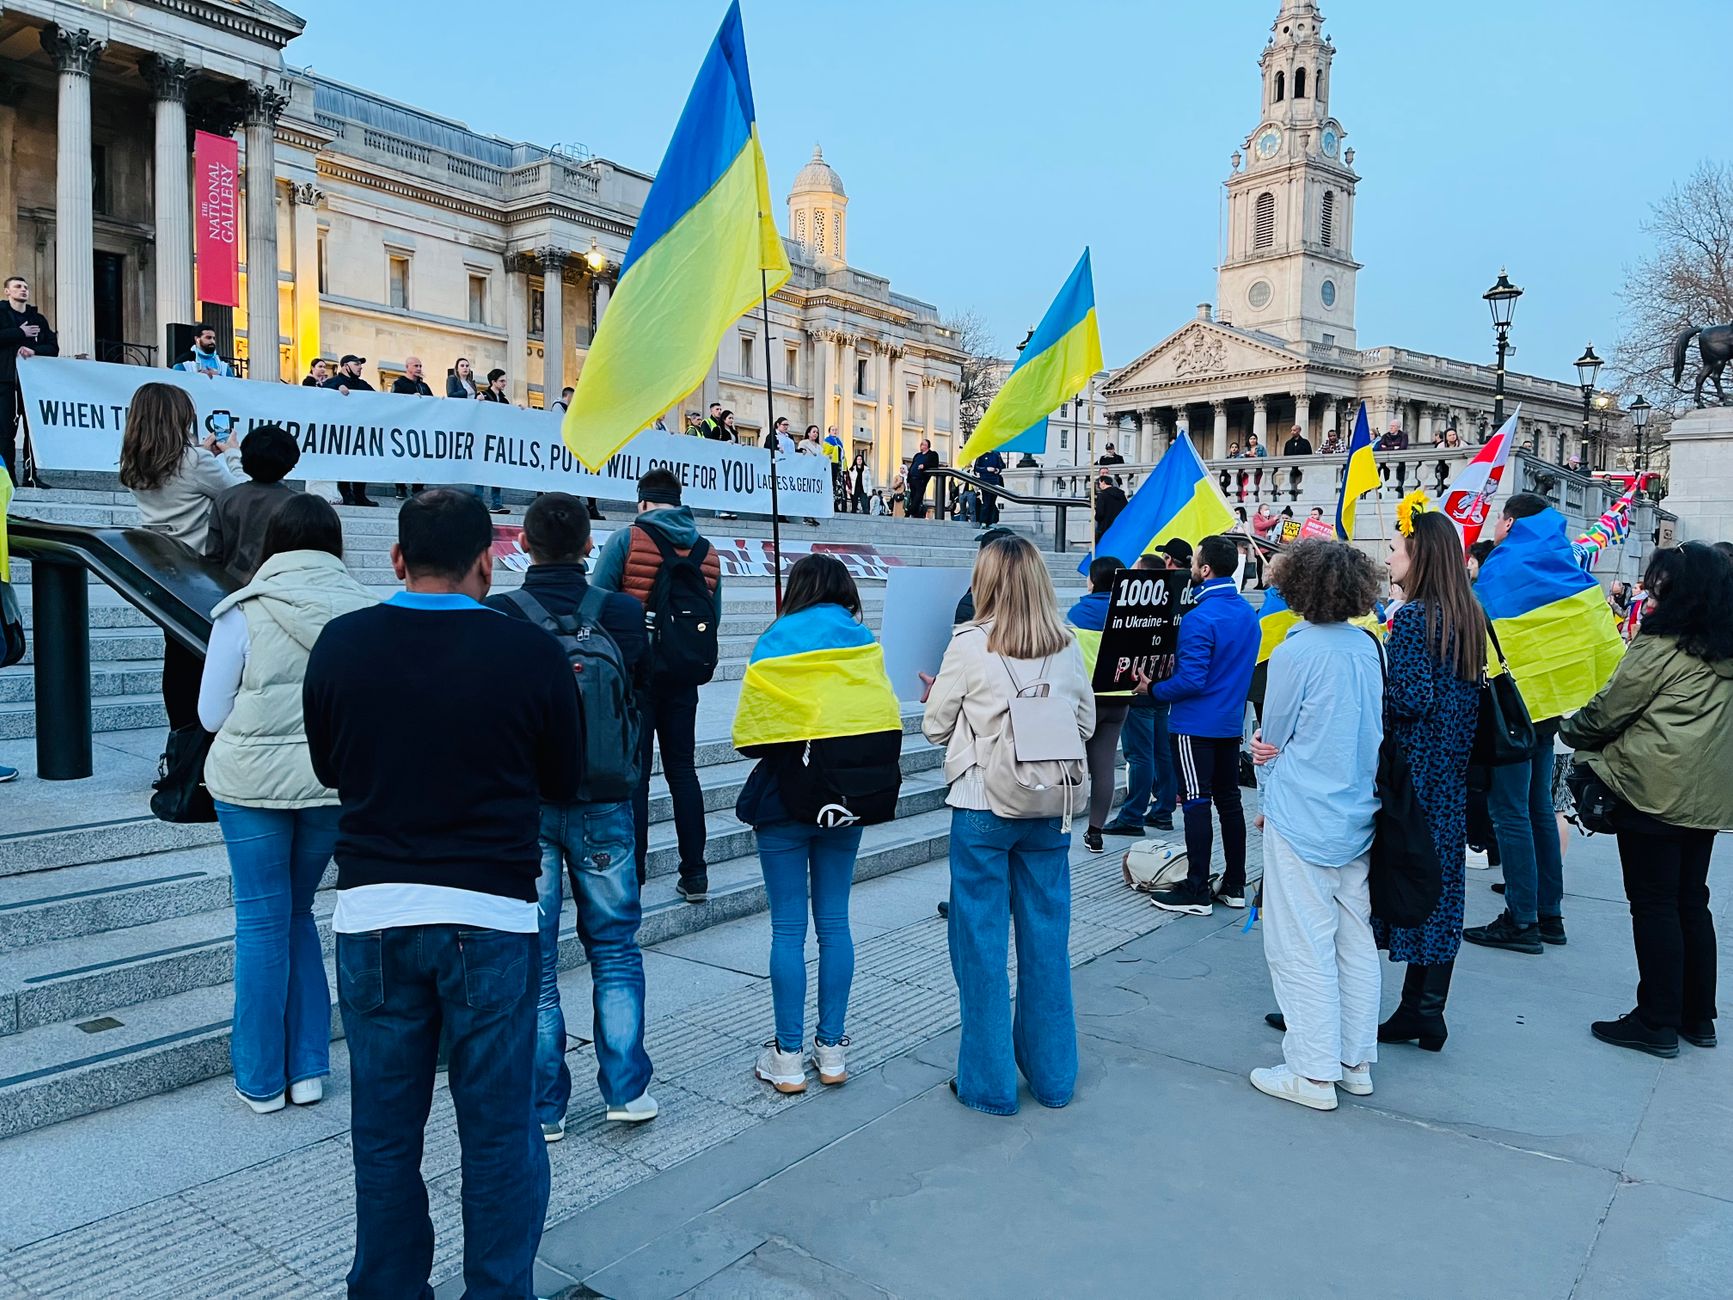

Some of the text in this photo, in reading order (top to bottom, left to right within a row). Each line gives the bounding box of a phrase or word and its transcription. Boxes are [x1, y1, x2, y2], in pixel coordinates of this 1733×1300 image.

[209, 162, 220, 240] NATIONAL
[221, 164, 234, 243] GALLERY
[39, 400, 105, 429] WHEN
[247, 418, 384, 457] RAINIAN
[390, 428, 474, 460] SOLDIER
[484, 434, 544, 472] FALLS,
[693, 464, 717, 490] FOR
[721, 459, 755, 494] YOU
[757, 473, 788, 491] LADES
[1116, 579, 1170, 606] 1000s
[1112, 616, 1123, 629] in
[1151, 635, 1162, 646] to
